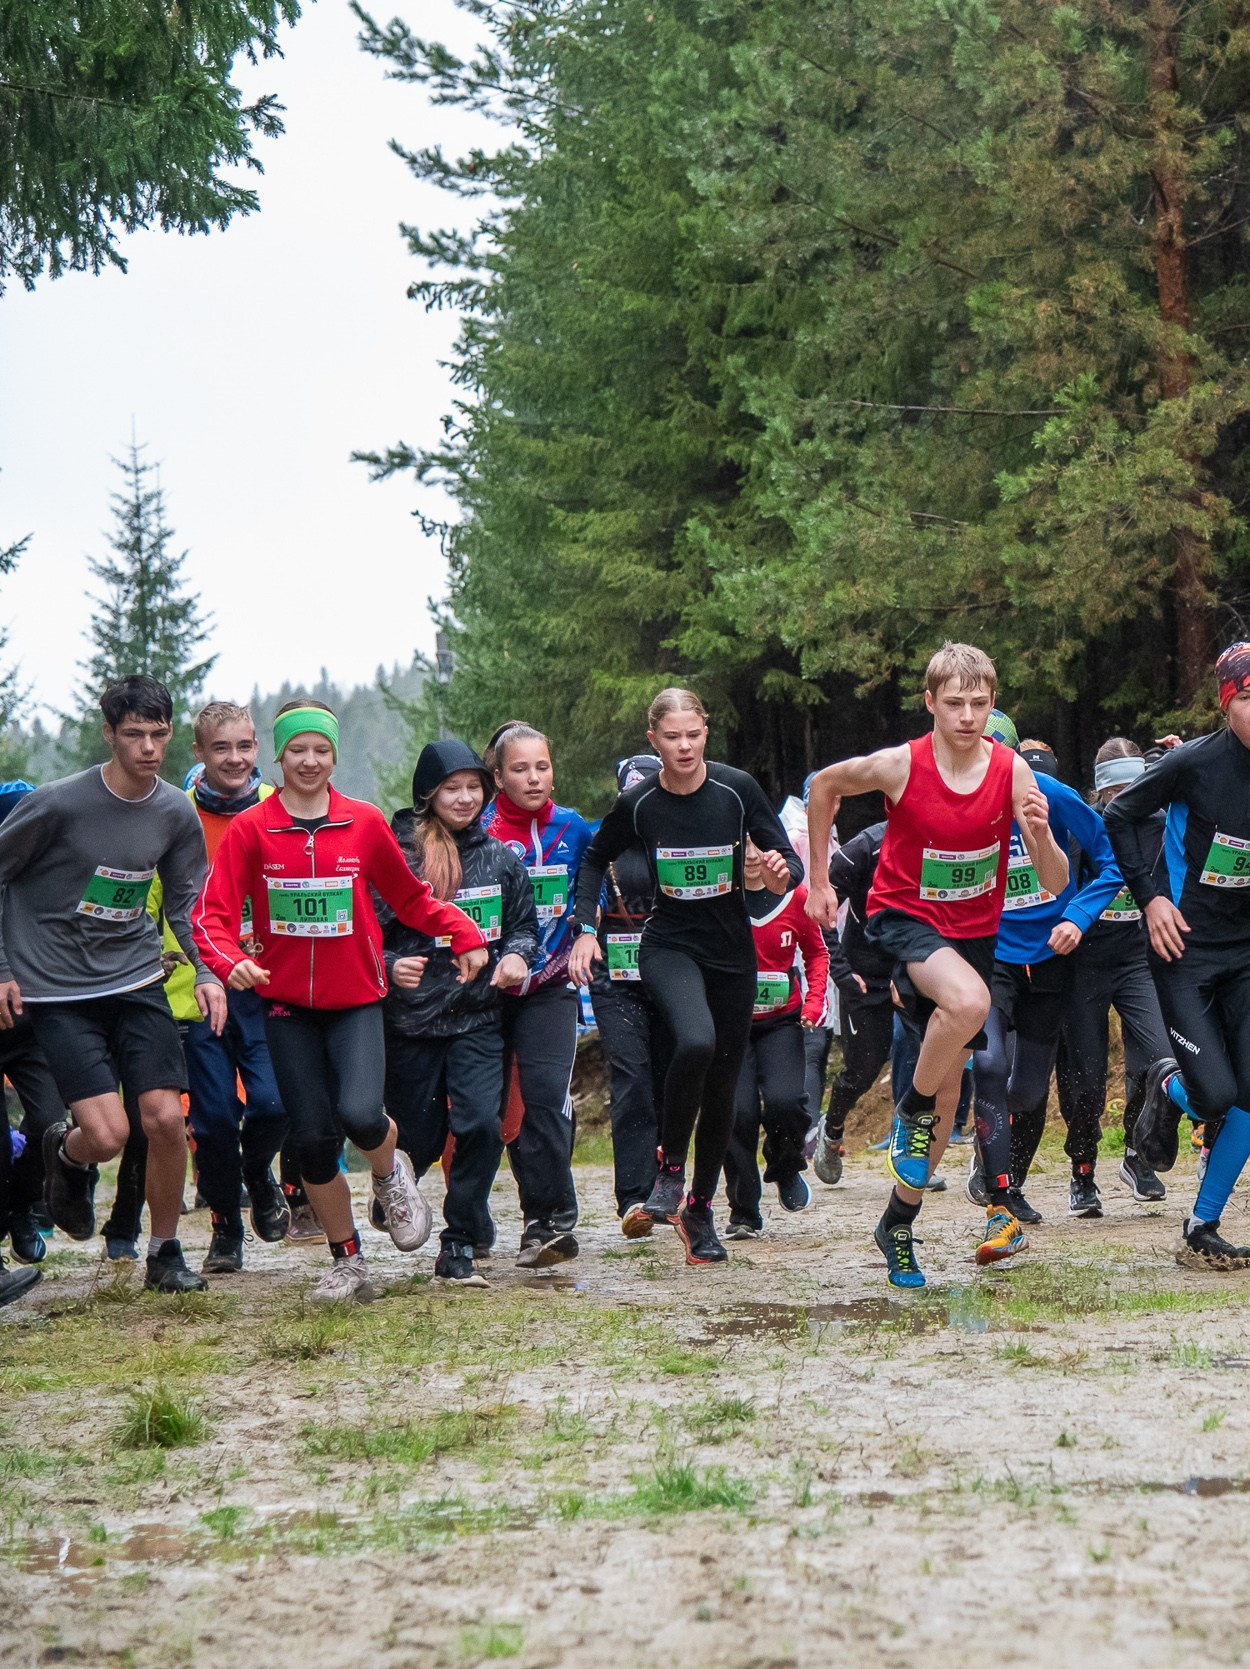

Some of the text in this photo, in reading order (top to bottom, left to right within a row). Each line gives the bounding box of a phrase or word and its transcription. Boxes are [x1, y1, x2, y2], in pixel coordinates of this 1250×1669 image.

[684, 864, 707, 881] 89
[951, 867, 976, 884] 99
[1007, 872, 1032, 892] 08
[112, 887, 136, 904] 82
[293, 898, 327, 917] 101
[780, 930, 793, 948] 17
[756, 987, 770, 1001] 4
[1170, 1026, 1201, 1055] VITZHEN
